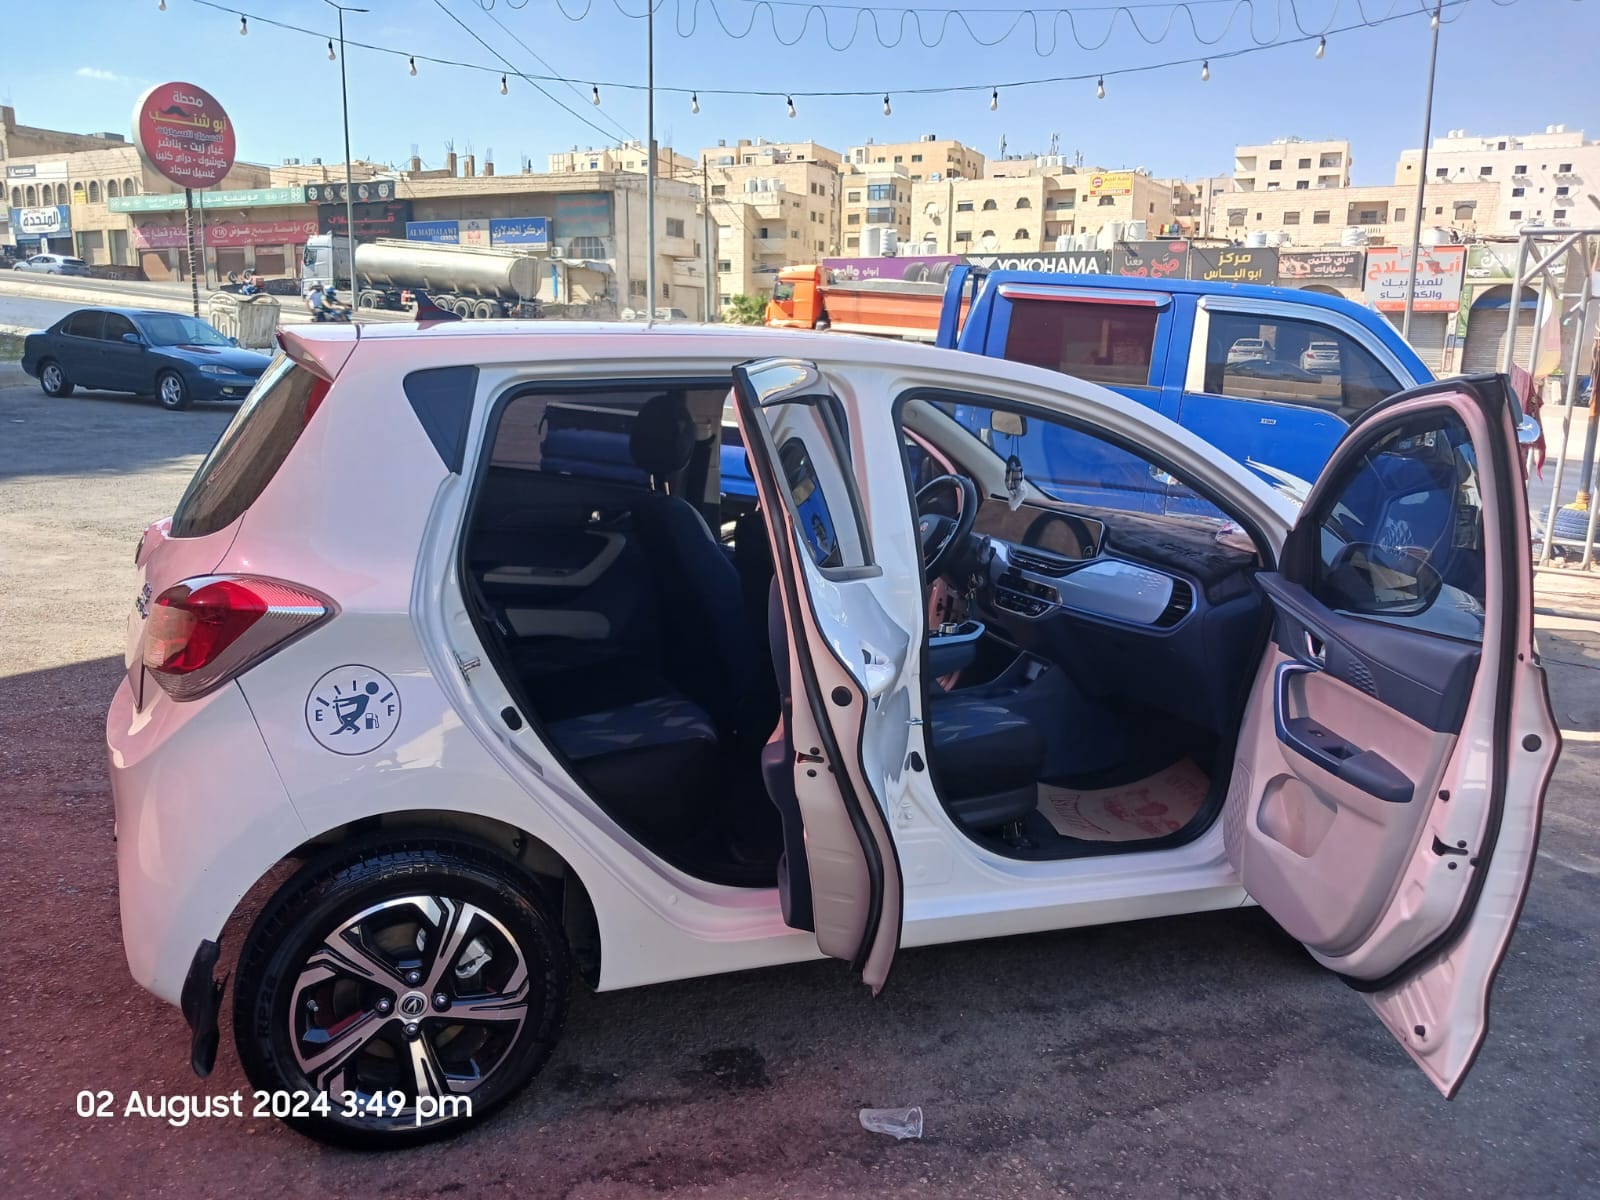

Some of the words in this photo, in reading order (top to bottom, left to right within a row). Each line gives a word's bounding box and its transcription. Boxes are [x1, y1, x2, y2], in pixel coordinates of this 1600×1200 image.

[172, 90, 204, 108] محطة
[212, 116, 227, 133] أبو
[189, 142, 205, 154] زيت
[207, 143, 224, 155] غيار
[169, 164, 191, 177] سجاد
[192, 167, 216, 179] غسيل
[23, 210, 59, 227] المتحدة
[522, 223, 545, 237] مركز
[997, 256, 1100, 274] YOKOHAMA
[1218, 251, 1252, 267] مركز
[1381, 277, 1444, 289] للميكنيك
[315, 709, 324, 722] E
[387, 704, 396, 717] F
